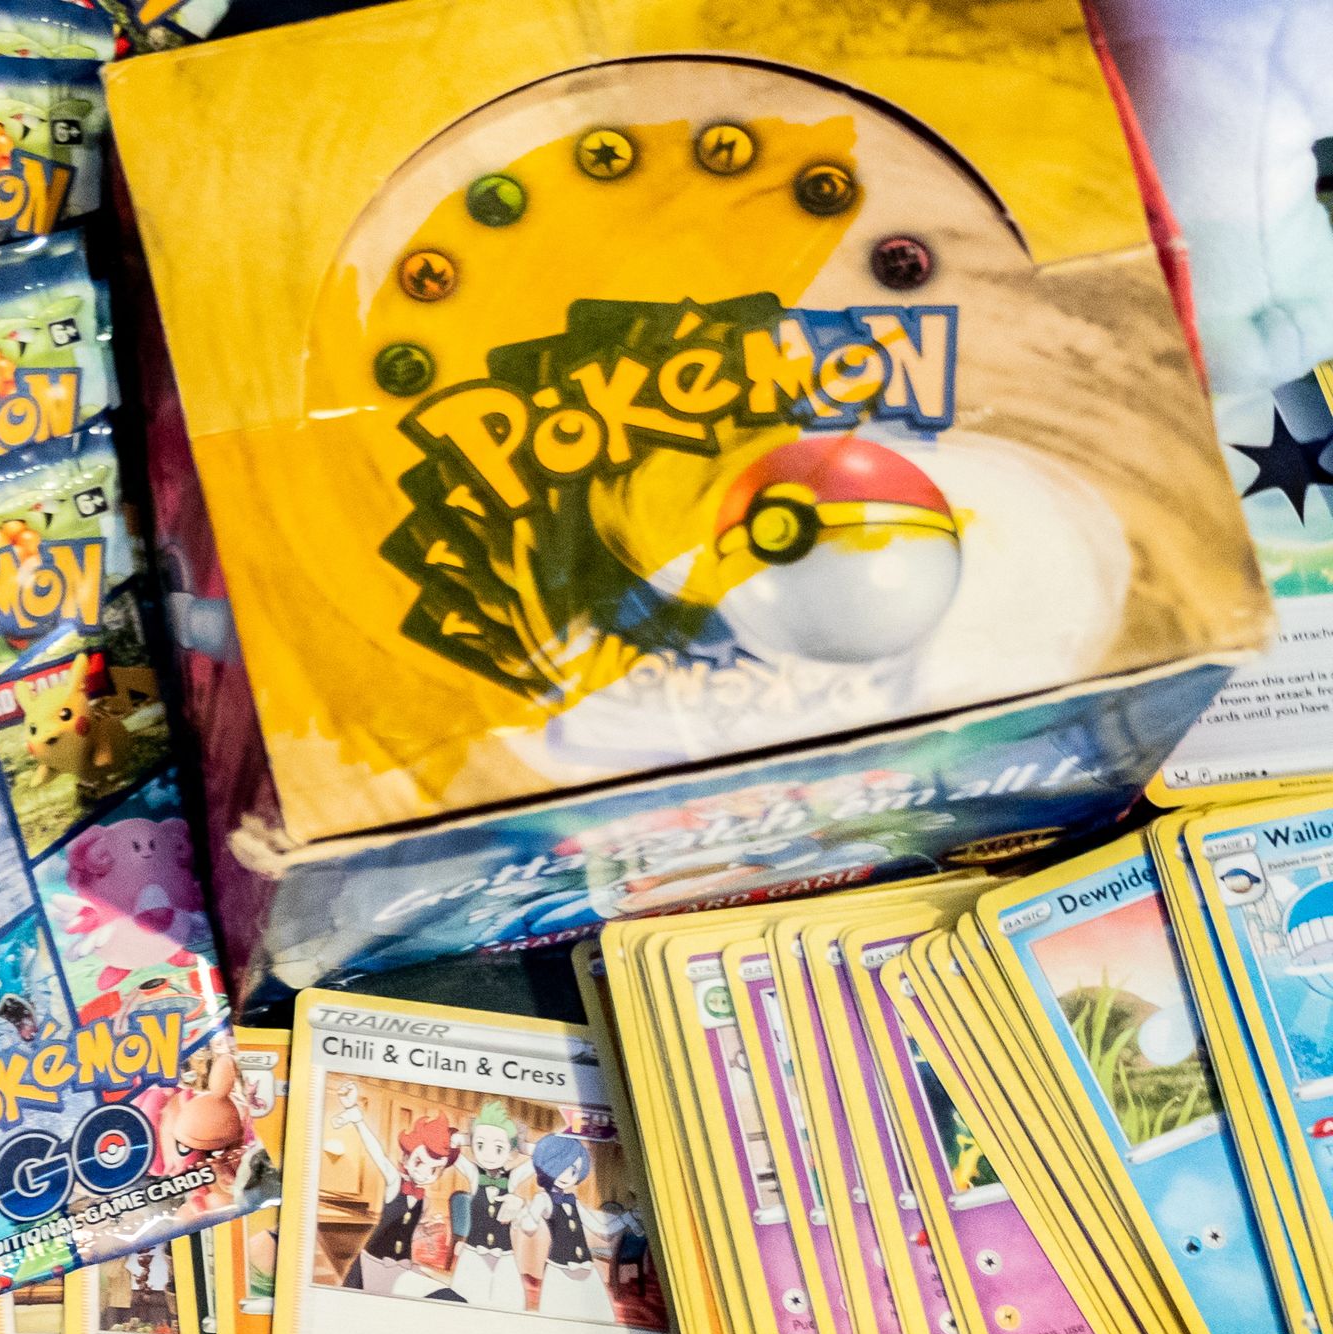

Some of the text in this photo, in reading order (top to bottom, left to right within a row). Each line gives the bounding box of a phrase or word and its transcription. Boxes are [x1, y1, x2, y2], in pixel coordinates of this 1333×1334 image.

[410, 303, 956, 513] Pokémon
[1288, 671, 1315, 687] card
[1219, 693, 1252, 707] from
[1274, 686, 1314, 701] attack
[1205, 702, 1330, 725] cards until you have
[317, 1008, 453, 1039] TRAINER
[321, 1036, 567, 1087] Chili & Cilan & Cress
[83, 1187, 146, 1225] GAME
[146, 1166, 216, 1203] CARDS
